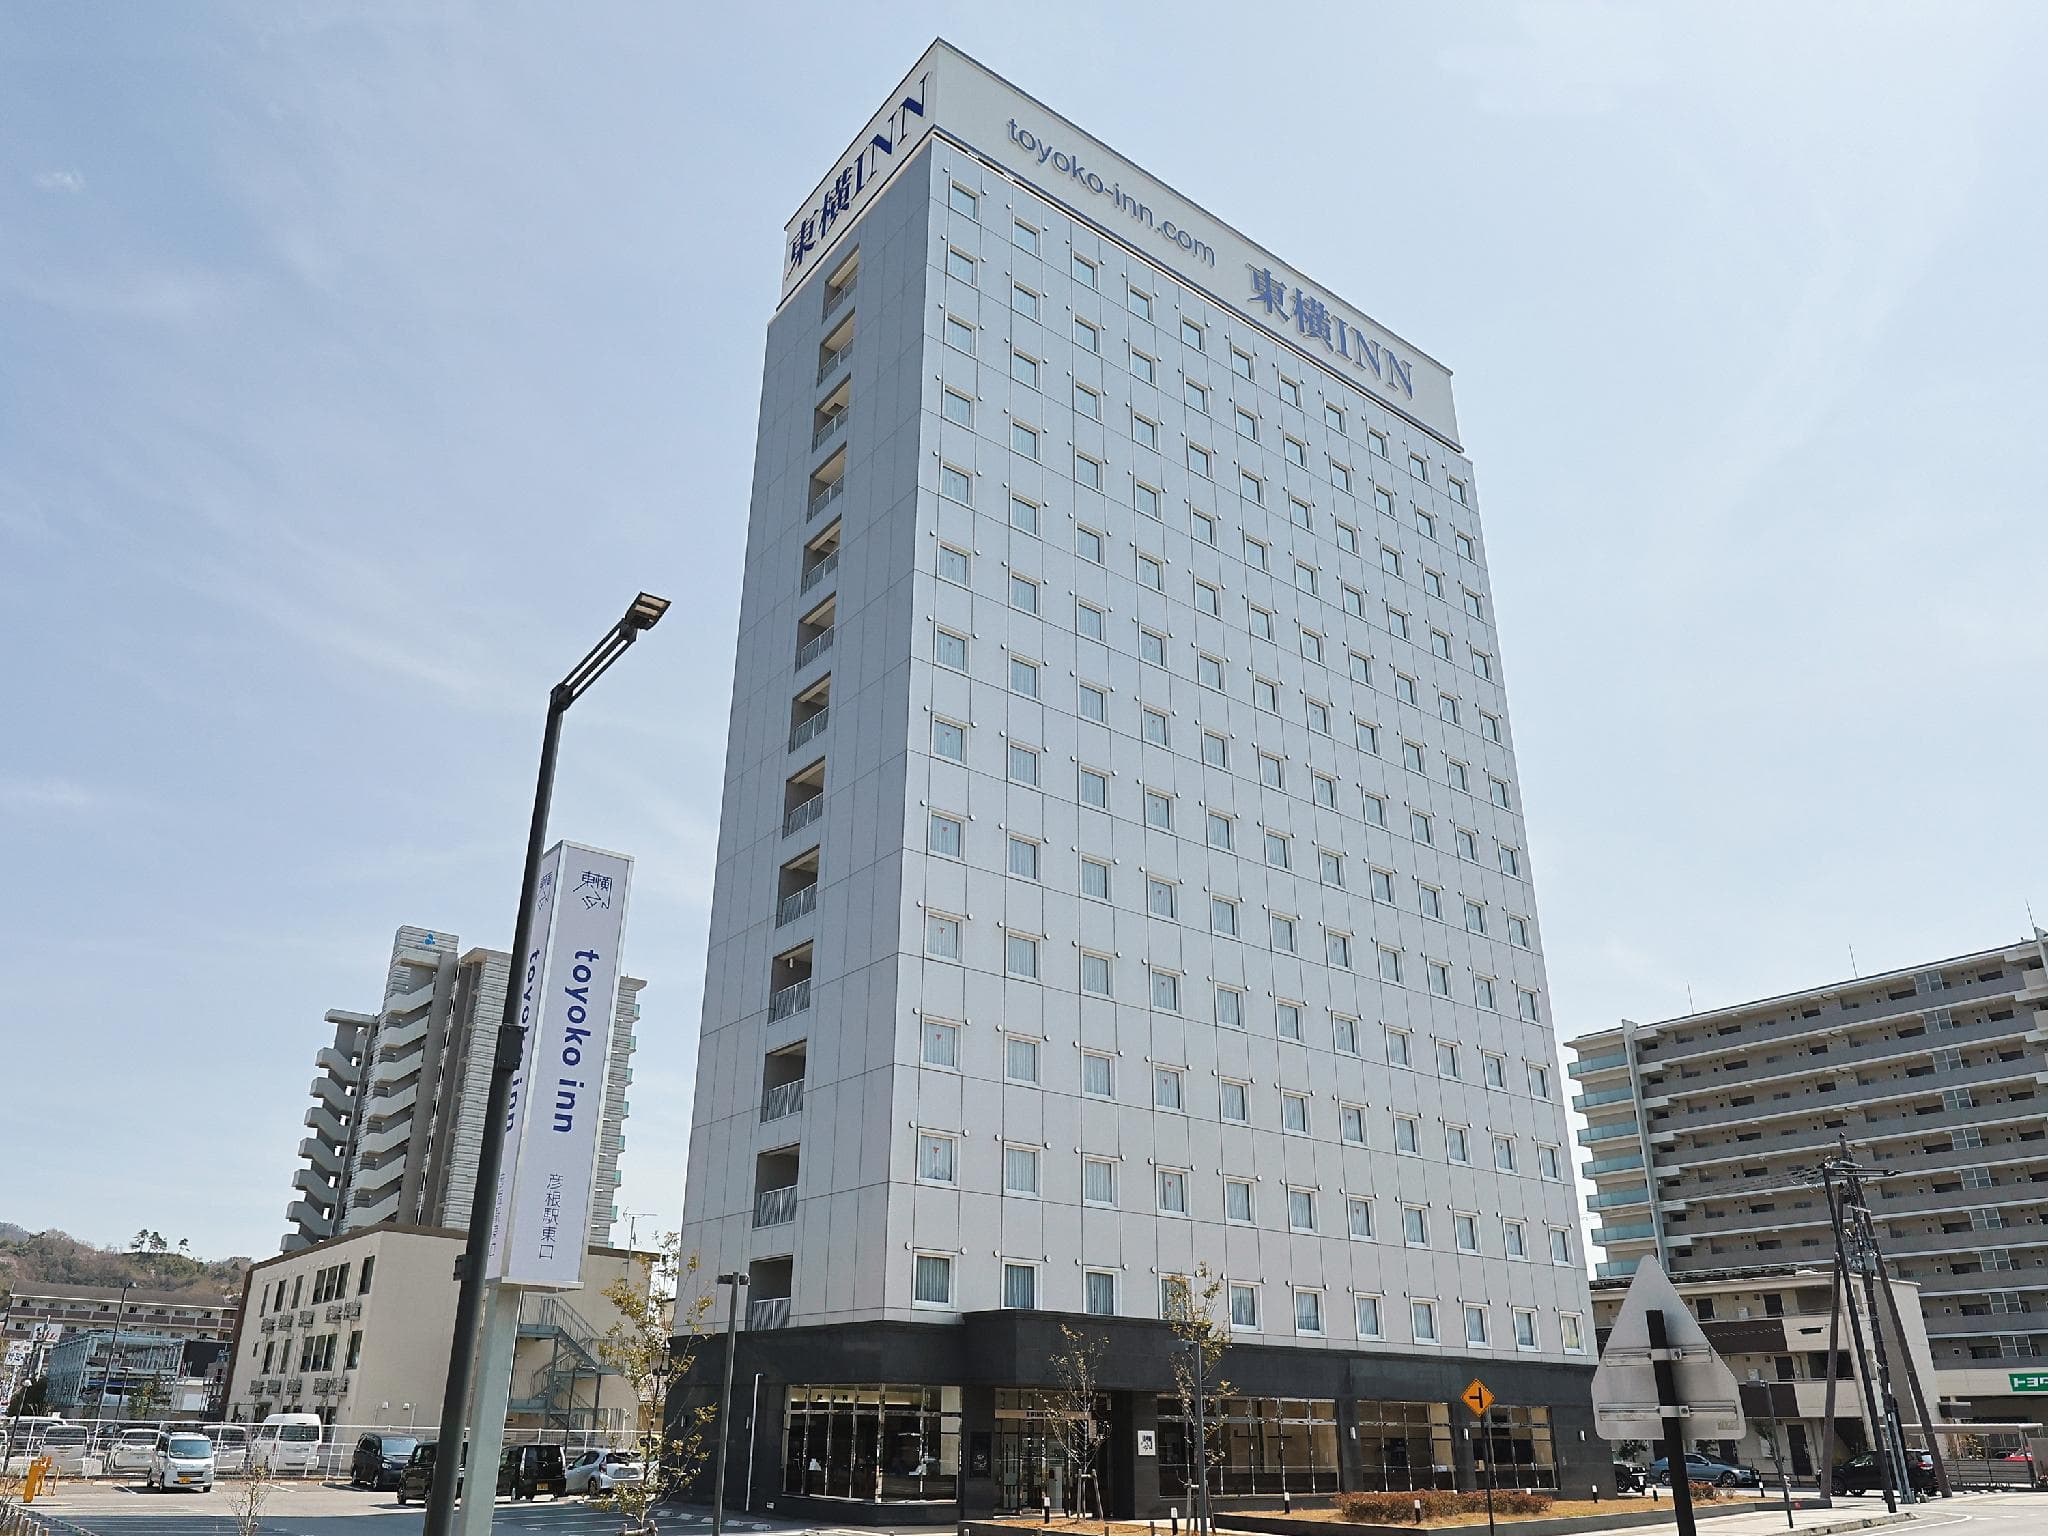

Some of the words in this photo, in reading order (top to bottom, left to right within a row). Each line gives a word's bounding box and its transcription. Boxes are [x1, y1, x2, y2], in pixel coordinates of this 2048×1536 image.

[786, 71, 930, 281] 東横INN
[1007, 117, 1216, 269] toyoko-inn.com
[1244, 262, 1414, 401] 東横INN
[562, 949, 600, 1066] toyoko
[552, 1078, 585, 1133] inn
[539, 1173, 564, 1260] 彦根駅東口
